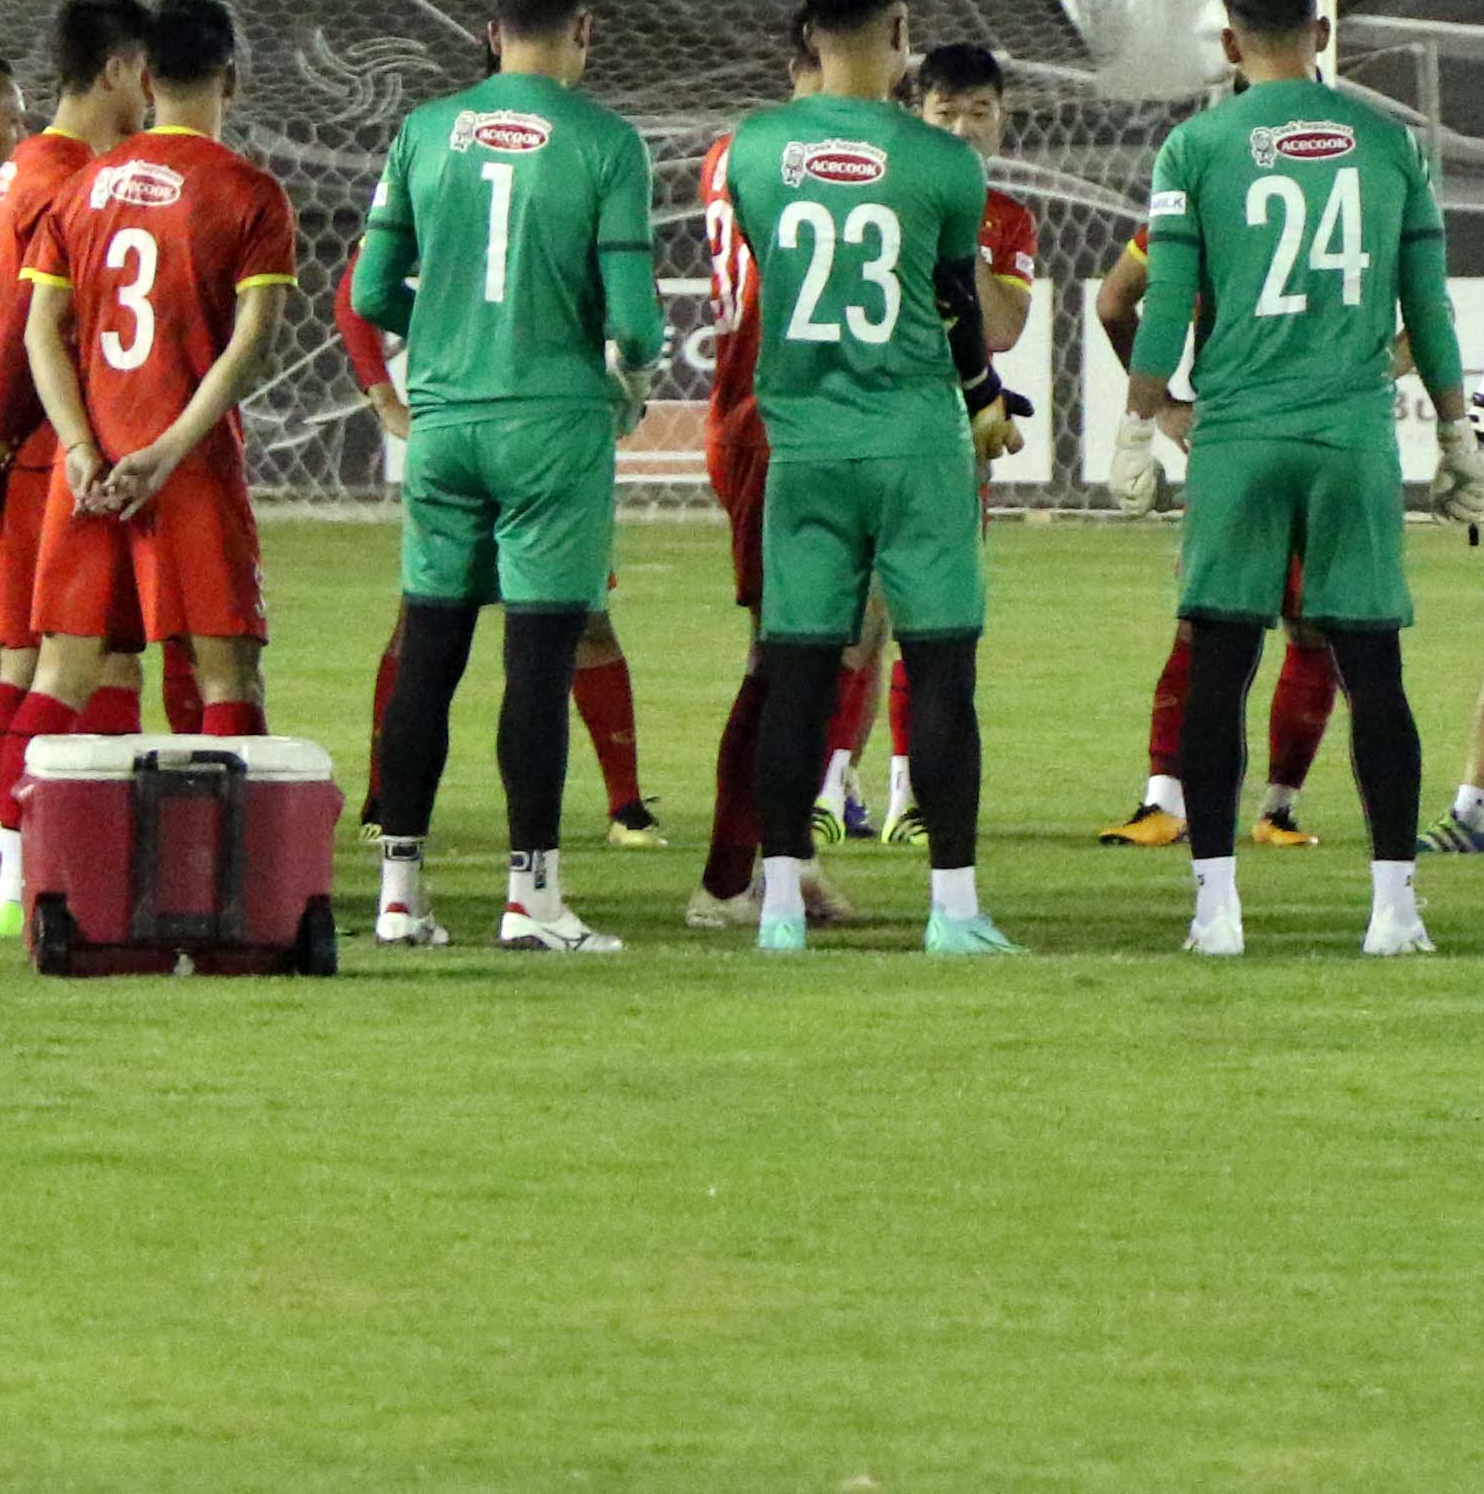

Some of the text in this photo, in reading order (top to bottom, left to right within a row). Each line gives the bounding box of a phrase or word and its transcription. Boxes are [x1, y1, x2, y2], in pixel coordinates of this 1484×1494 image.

[99, 226, 159, 371] 3
[480, 162, 514, 304] 1
[777, 200, 903, 344] 23
[1245, 166, 1371, 318] 24
